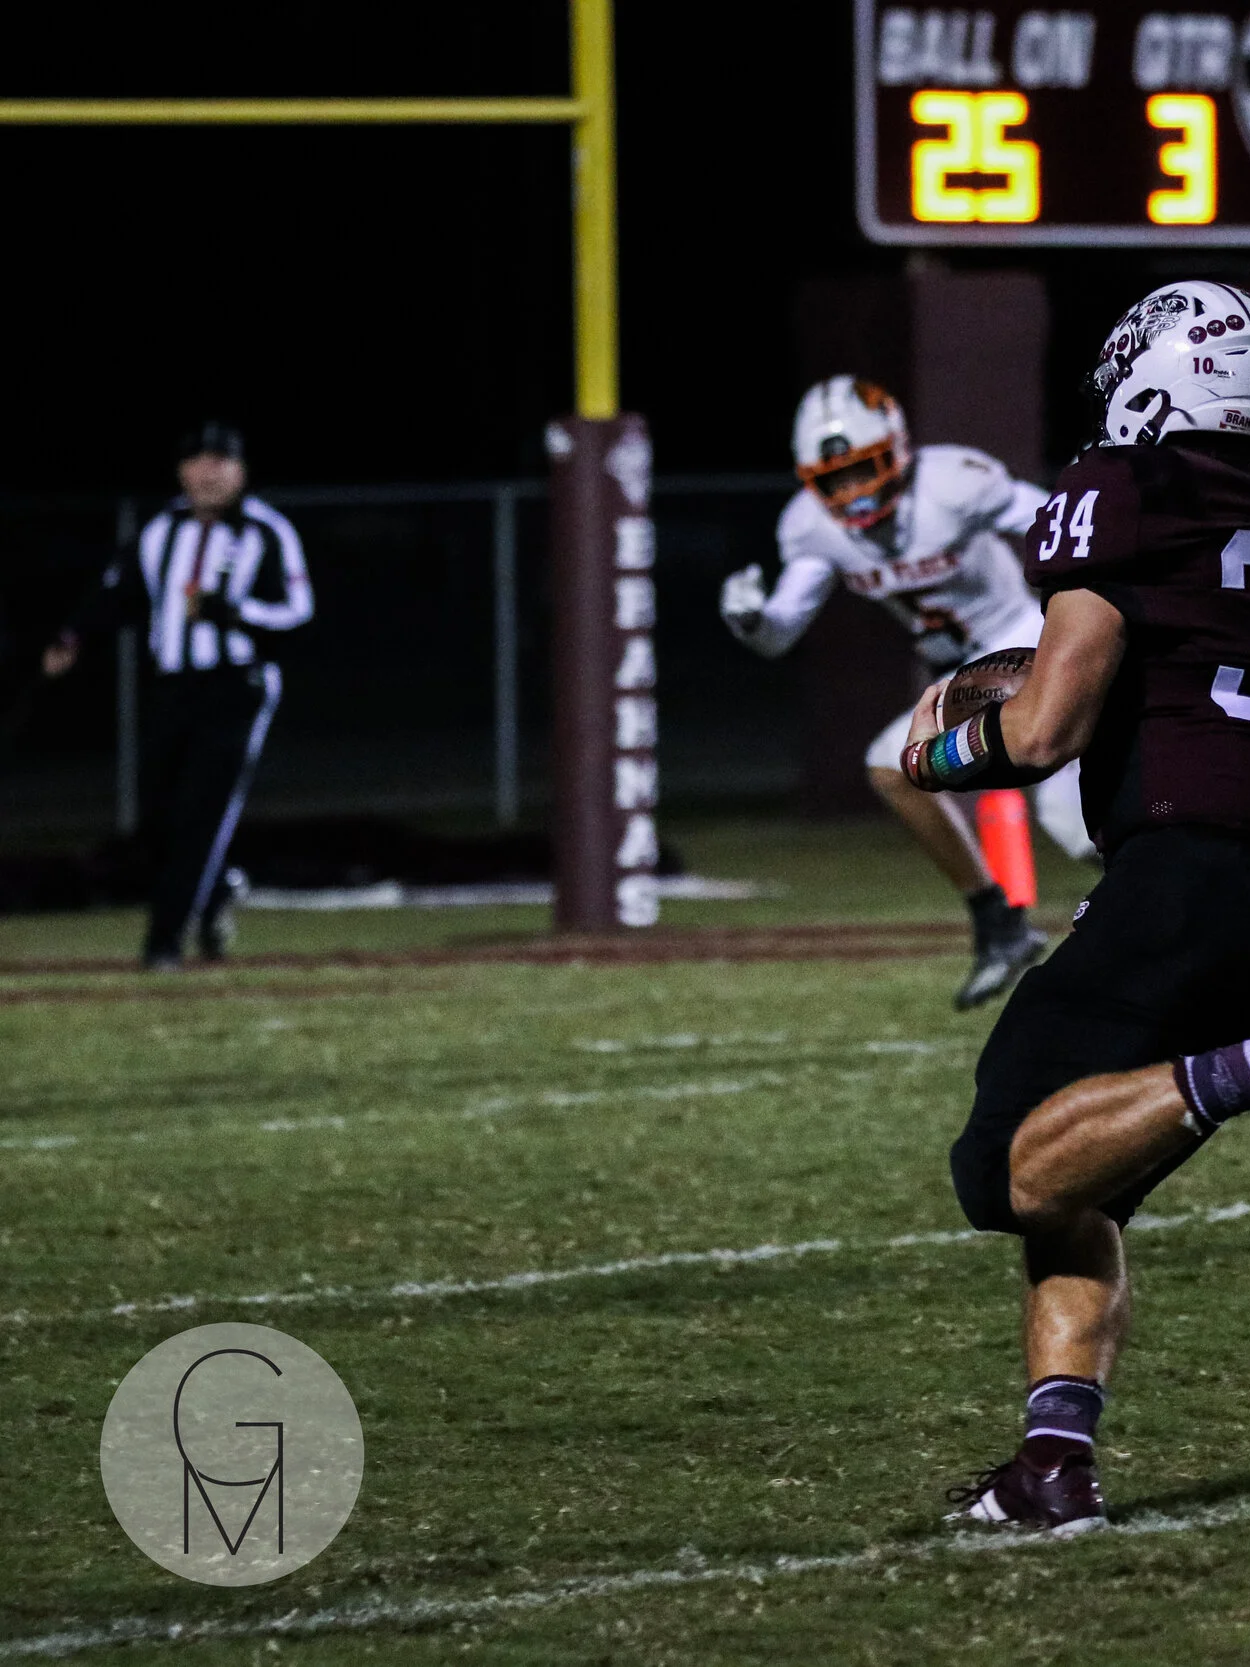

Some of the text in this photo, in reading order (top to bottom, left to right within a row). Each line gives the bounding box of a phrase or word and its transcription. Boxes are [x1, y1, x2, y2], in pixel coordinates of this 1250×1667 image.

[878, 11, 1000, 87] BALL
[911, 90, 1041, 223] 25
[1146, 94, 1217, 224] 3
[1193, 357, 1214, 374] 10
[1038, 490, 1099, 561] 34
